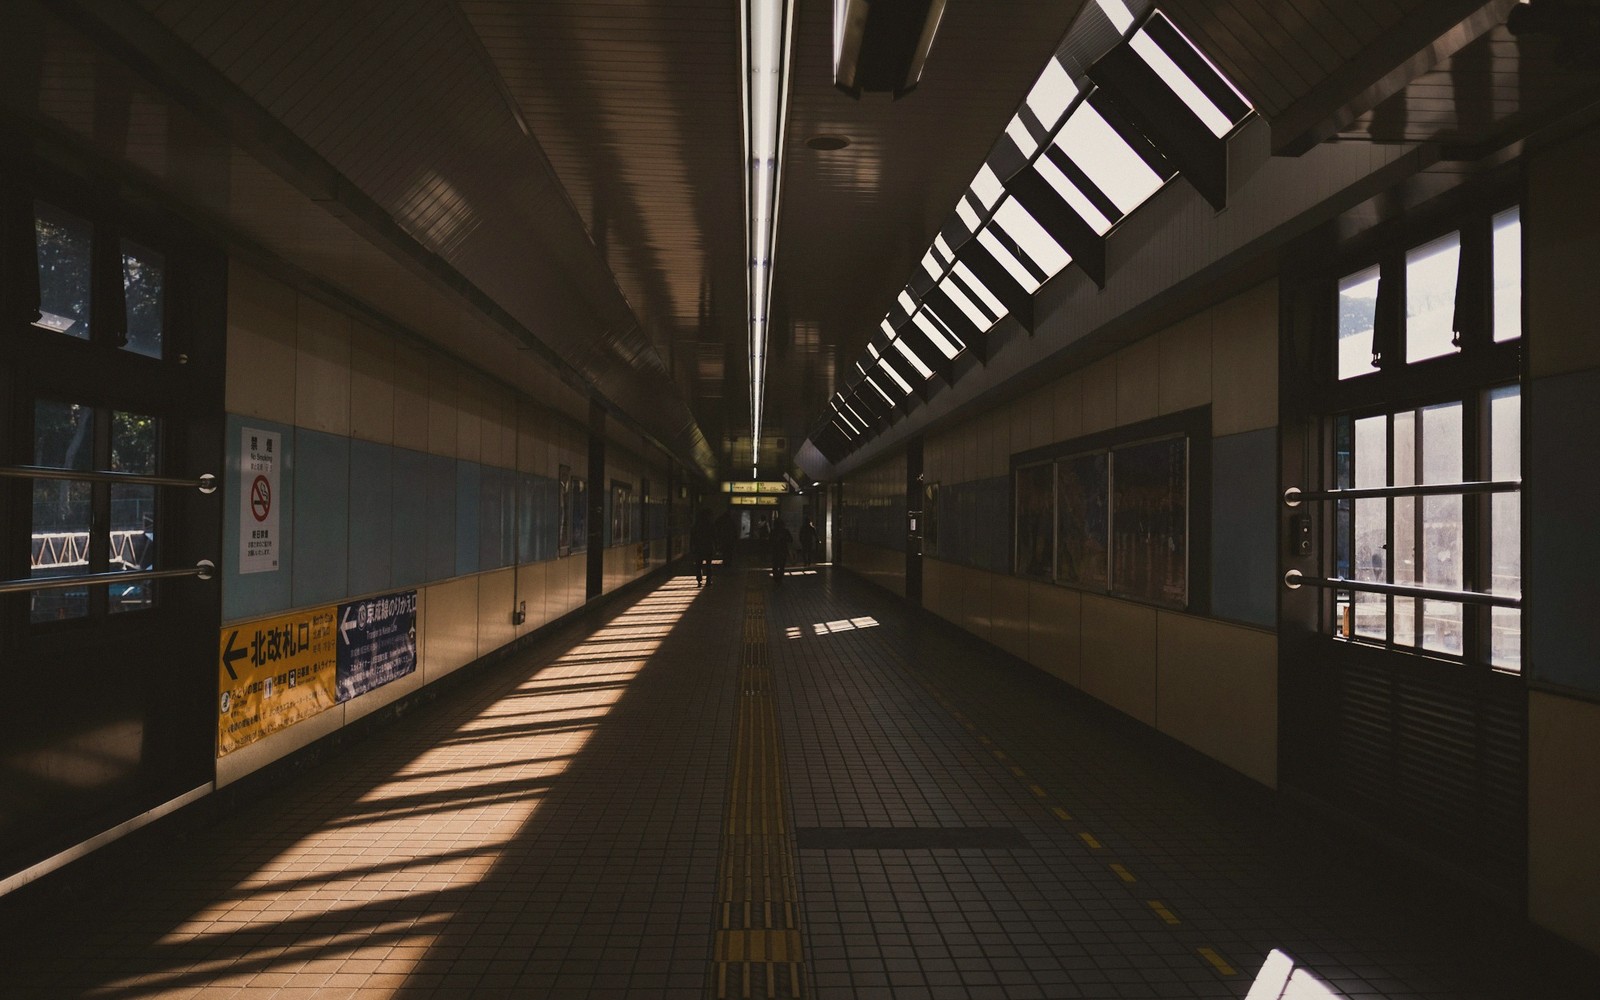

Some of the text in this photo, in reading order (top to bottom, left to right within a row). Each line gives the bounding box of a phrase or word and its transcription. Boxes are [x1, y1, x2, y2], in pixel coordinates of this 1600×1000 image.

[367, 595, 416, 623] 京成線のりかえ口
[251, 623, 309, 668] 北改札口
